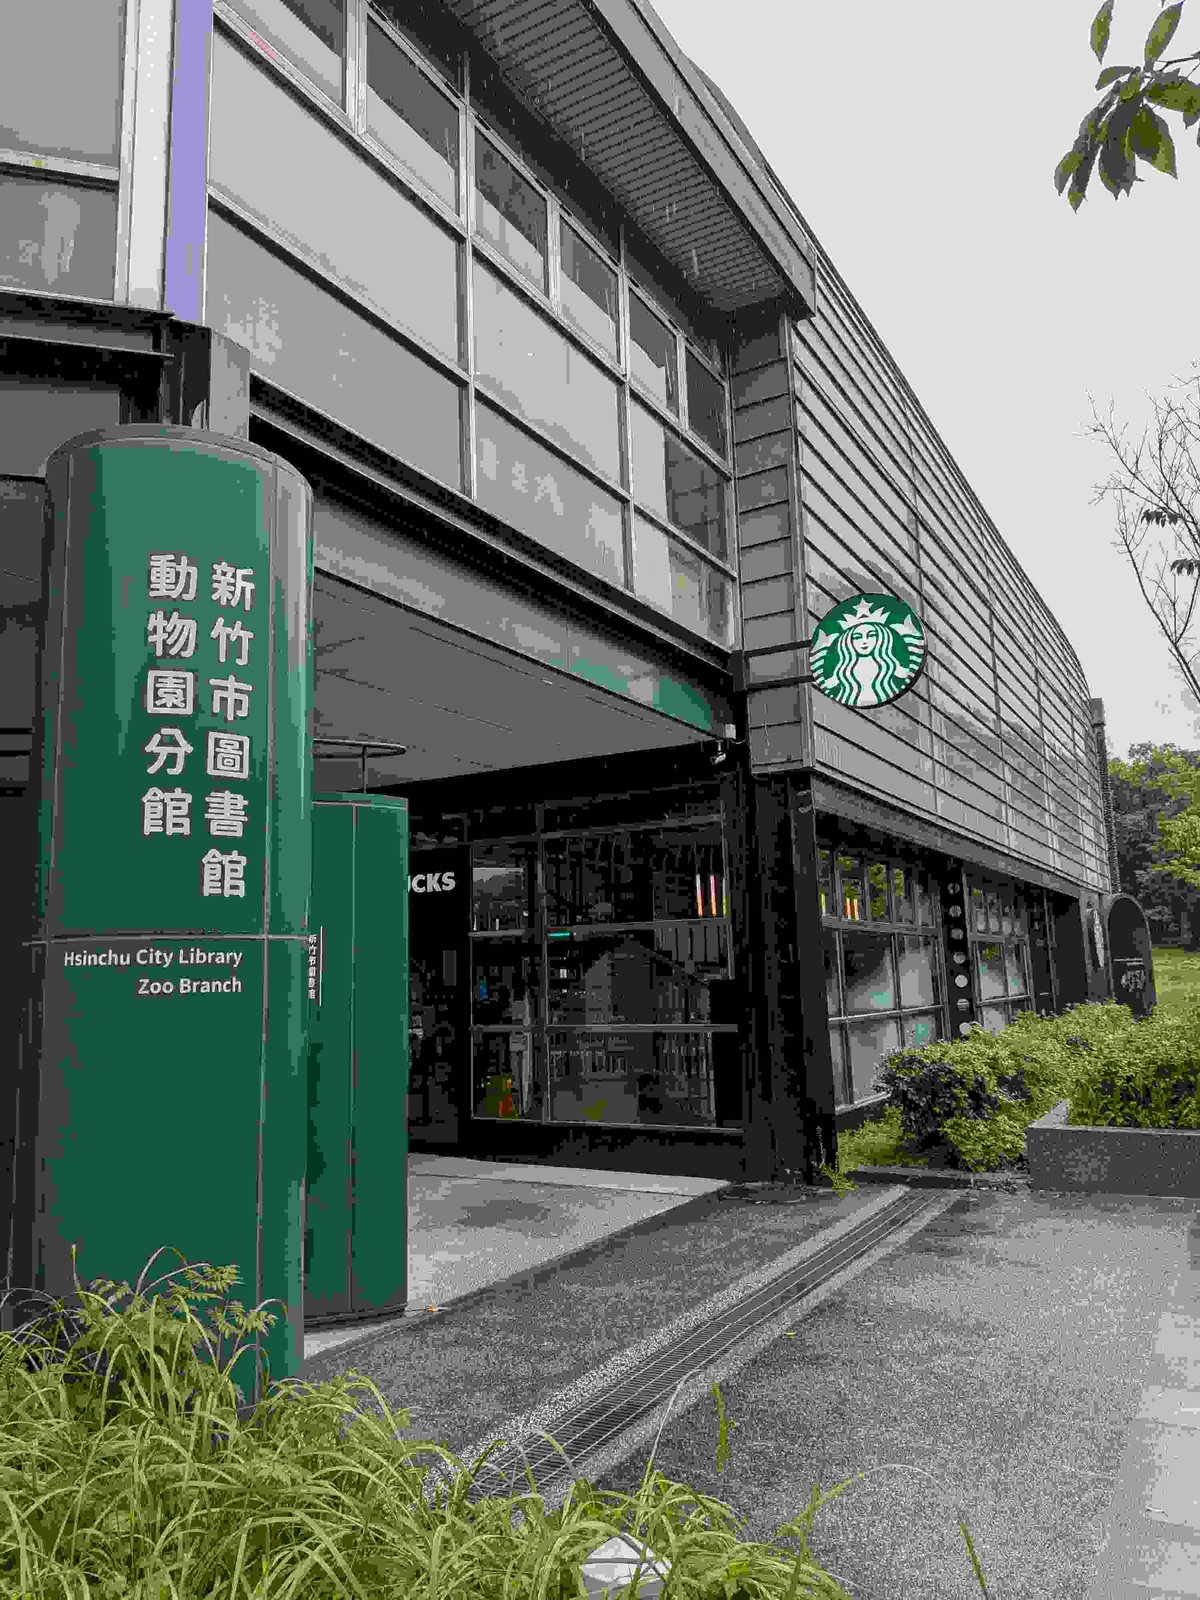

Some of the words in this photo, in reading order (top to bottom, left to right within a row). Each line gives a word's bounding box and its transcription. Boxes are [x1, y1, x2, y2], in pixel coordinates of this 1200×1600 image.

[141, 553, 198, 836] 動物園分館
[202, 560, 254, 898] 新竹市圖書館
[408, 871, 456, 893] CKS
[64, 949, 131, 967] Hsinchu
[136, 948, 174, 968] City
[179, 947, 243, 968] Library
[138, 979, 174, 995] Zoo
[179, 976, 242, 994] Branch
